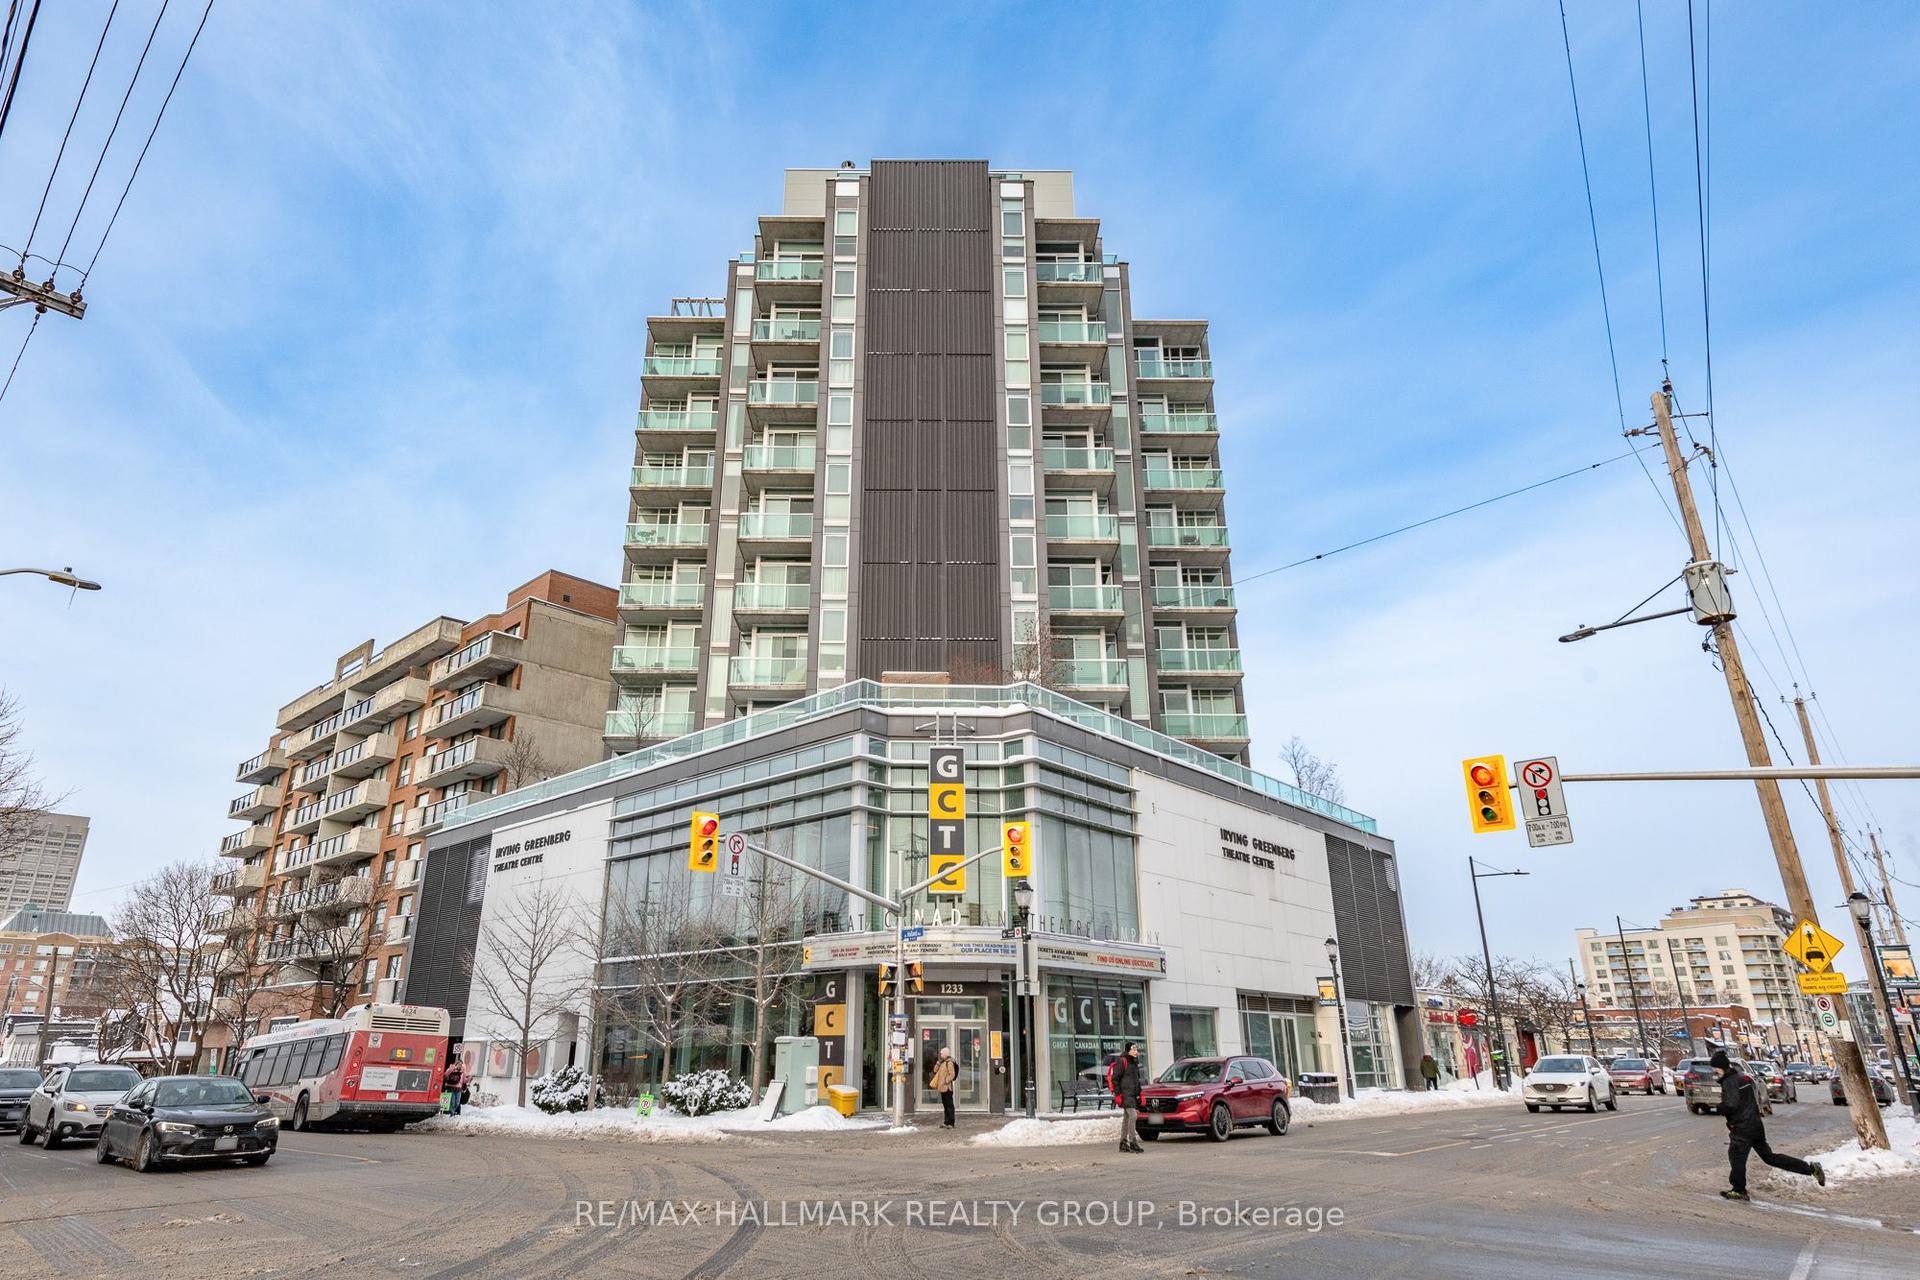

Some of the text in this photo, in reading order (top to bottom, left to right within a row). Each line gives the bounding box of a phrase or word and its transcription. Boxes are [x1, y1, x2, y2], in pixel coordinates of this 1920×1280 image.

[936, 754, 959, 886] GCTC
[495, 830, 571, 859] IRVING GREENBERG
[1220, 827, 1296, 861] IRVING GREENBERG
[493, 853, 544, 873] THEATRE CENTRE
[1221, 846, 1275, 870] THEATRE CENTRE
[1029, 913, 1092, 938] THEATRE
[1054, 948, 1076, 956] AVAILABLE
[1115, 957, 1131, 966] ONLINE
[940, 983, 965, 995] 1233
[1053, 996, 1140, 1027] GCTC
[395, 1049, 407, 1058] 51
[1074, 1041, 1100, 1050] CANADIAN
[1102, 1042, 1121, 1050] THEATRE
